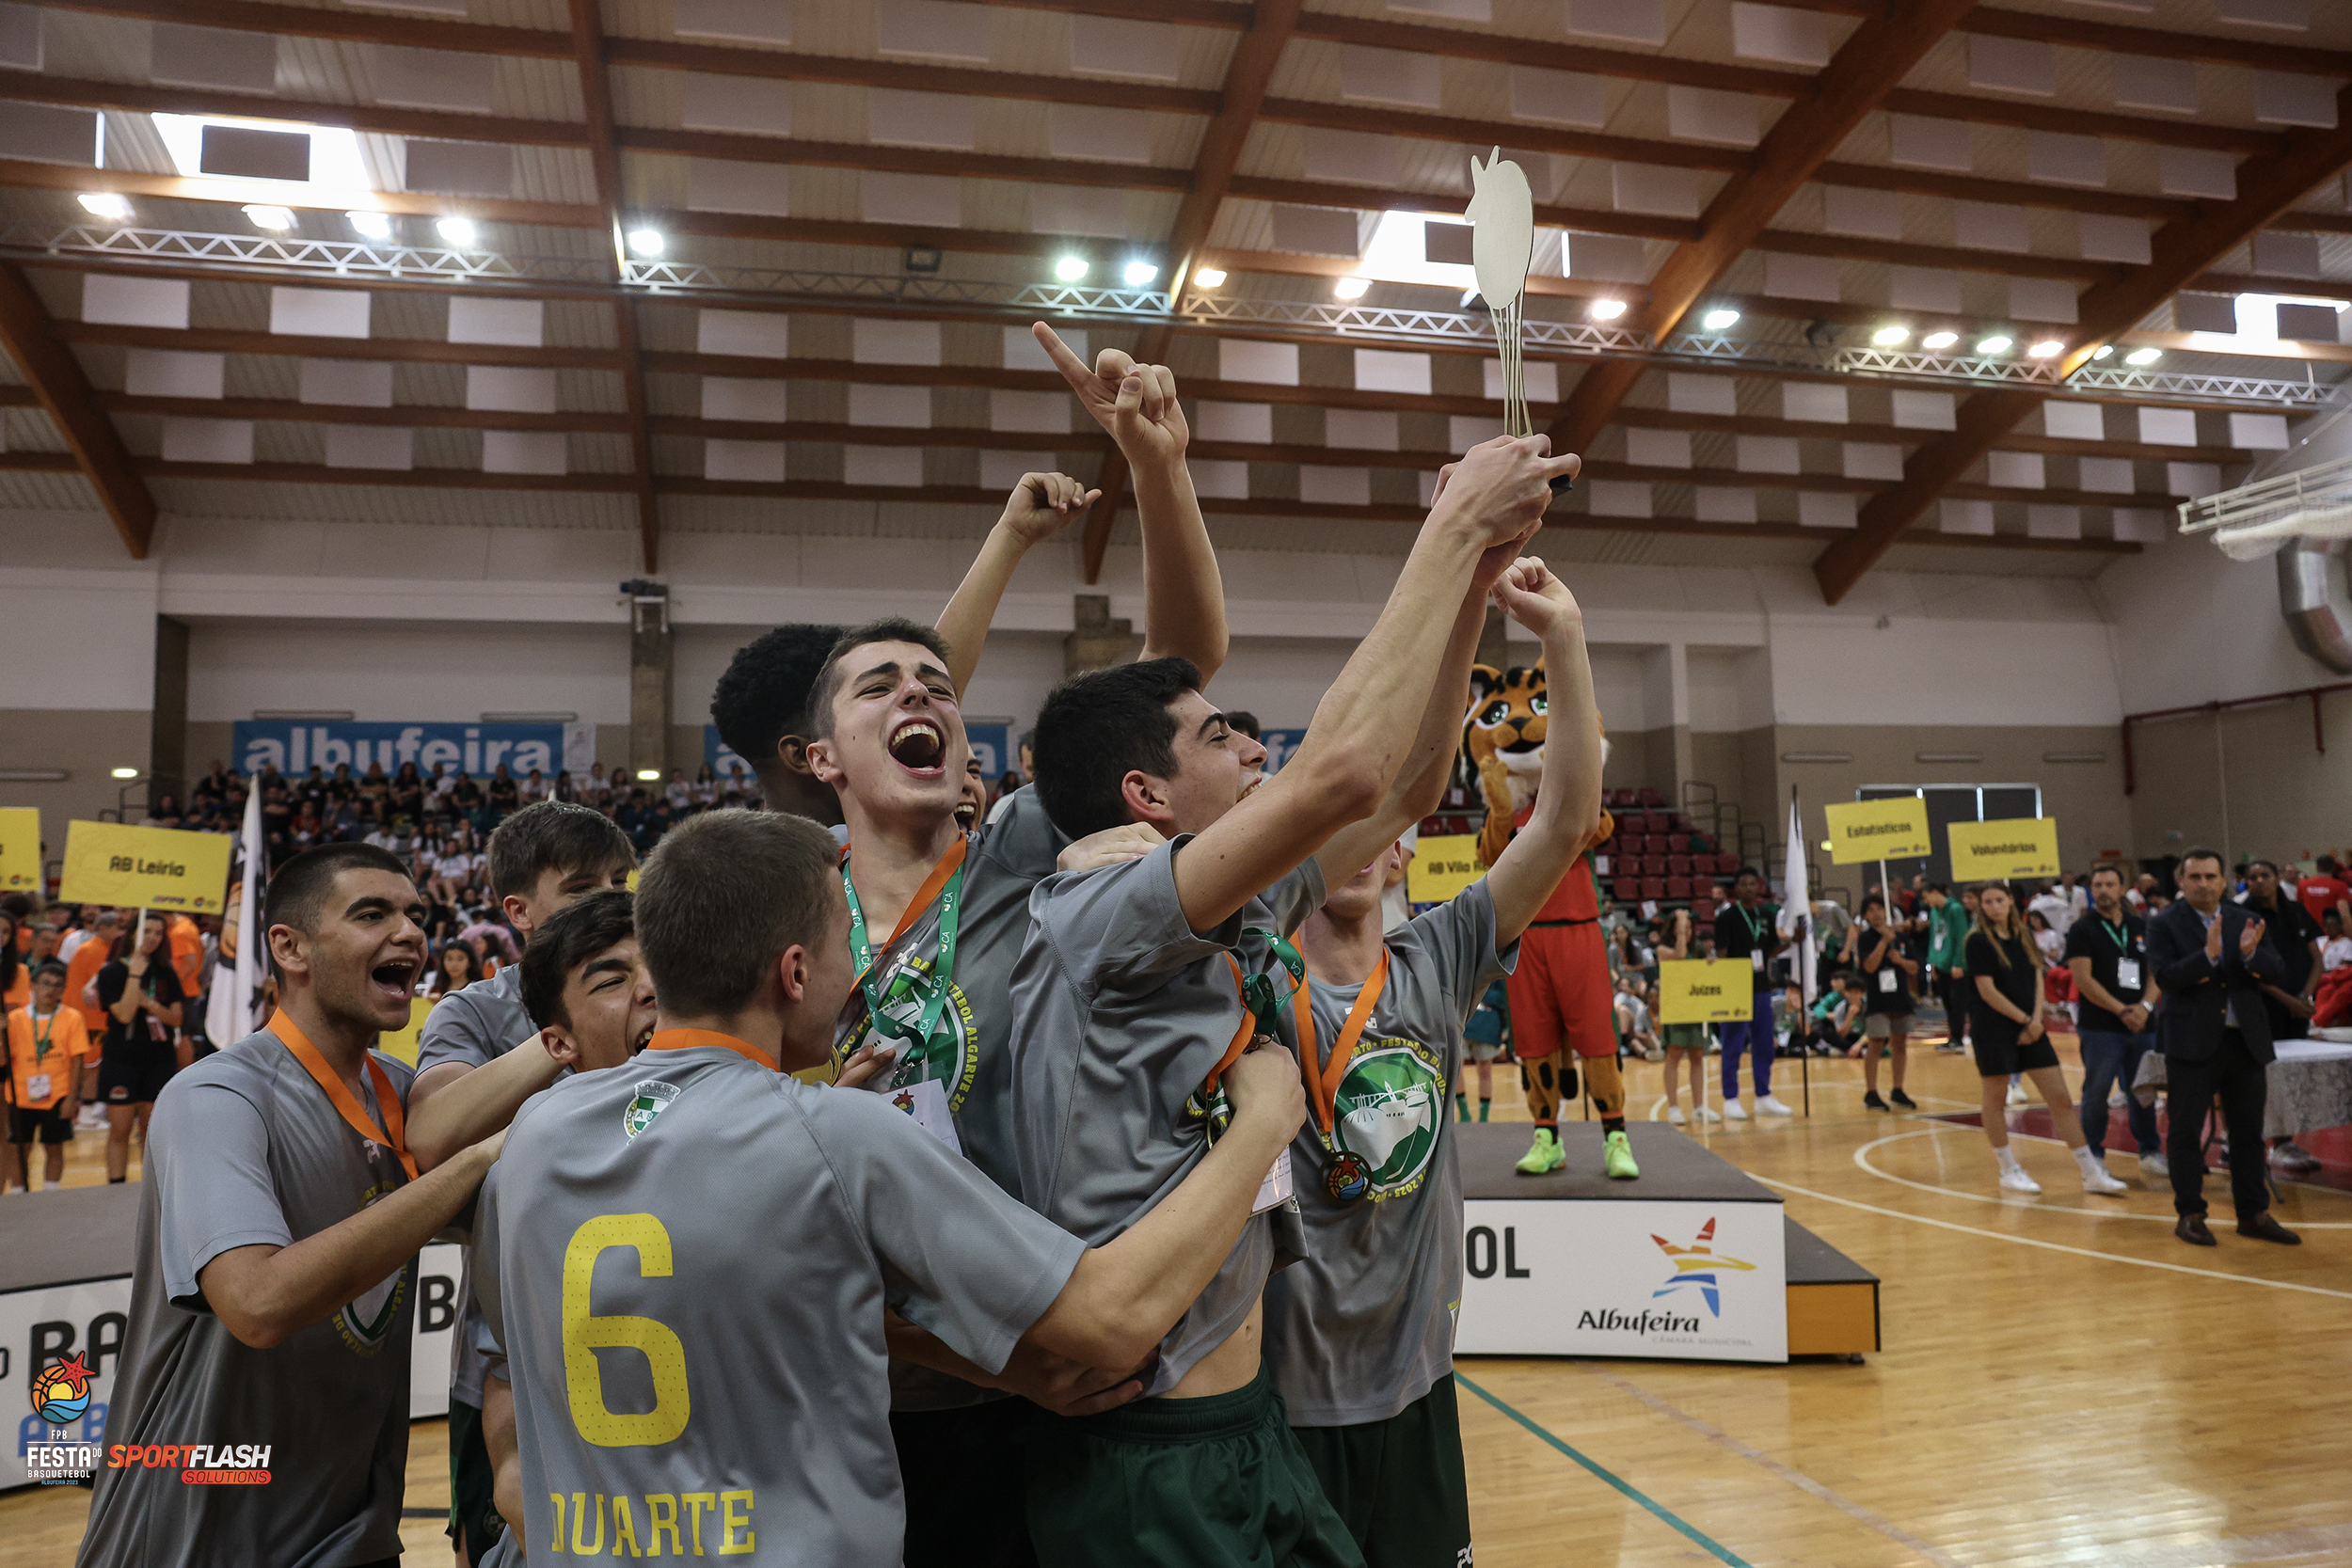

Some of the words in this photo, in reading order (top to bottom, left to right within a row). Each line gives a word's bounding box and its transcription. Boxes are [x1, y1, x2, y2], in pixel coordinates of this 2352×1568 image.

[245, 727, 551, 775] albufeira
[109, 855, 133, 872] AB
[137, 859, 185, 877] Leiria
[944, 892, 954, 903] CA
[941, 931, 950, 943] CA
[932, 974, 945, 988] CA
[919, 1018, 931, 1030] CA
[959, 1026, 979, 1093] ALGARVE
[563, 1212, 691, 1447] 6
[1577, 1307, 1699, 1336] Albufeira
[550, 1489, 755, 1558] DUARTE
